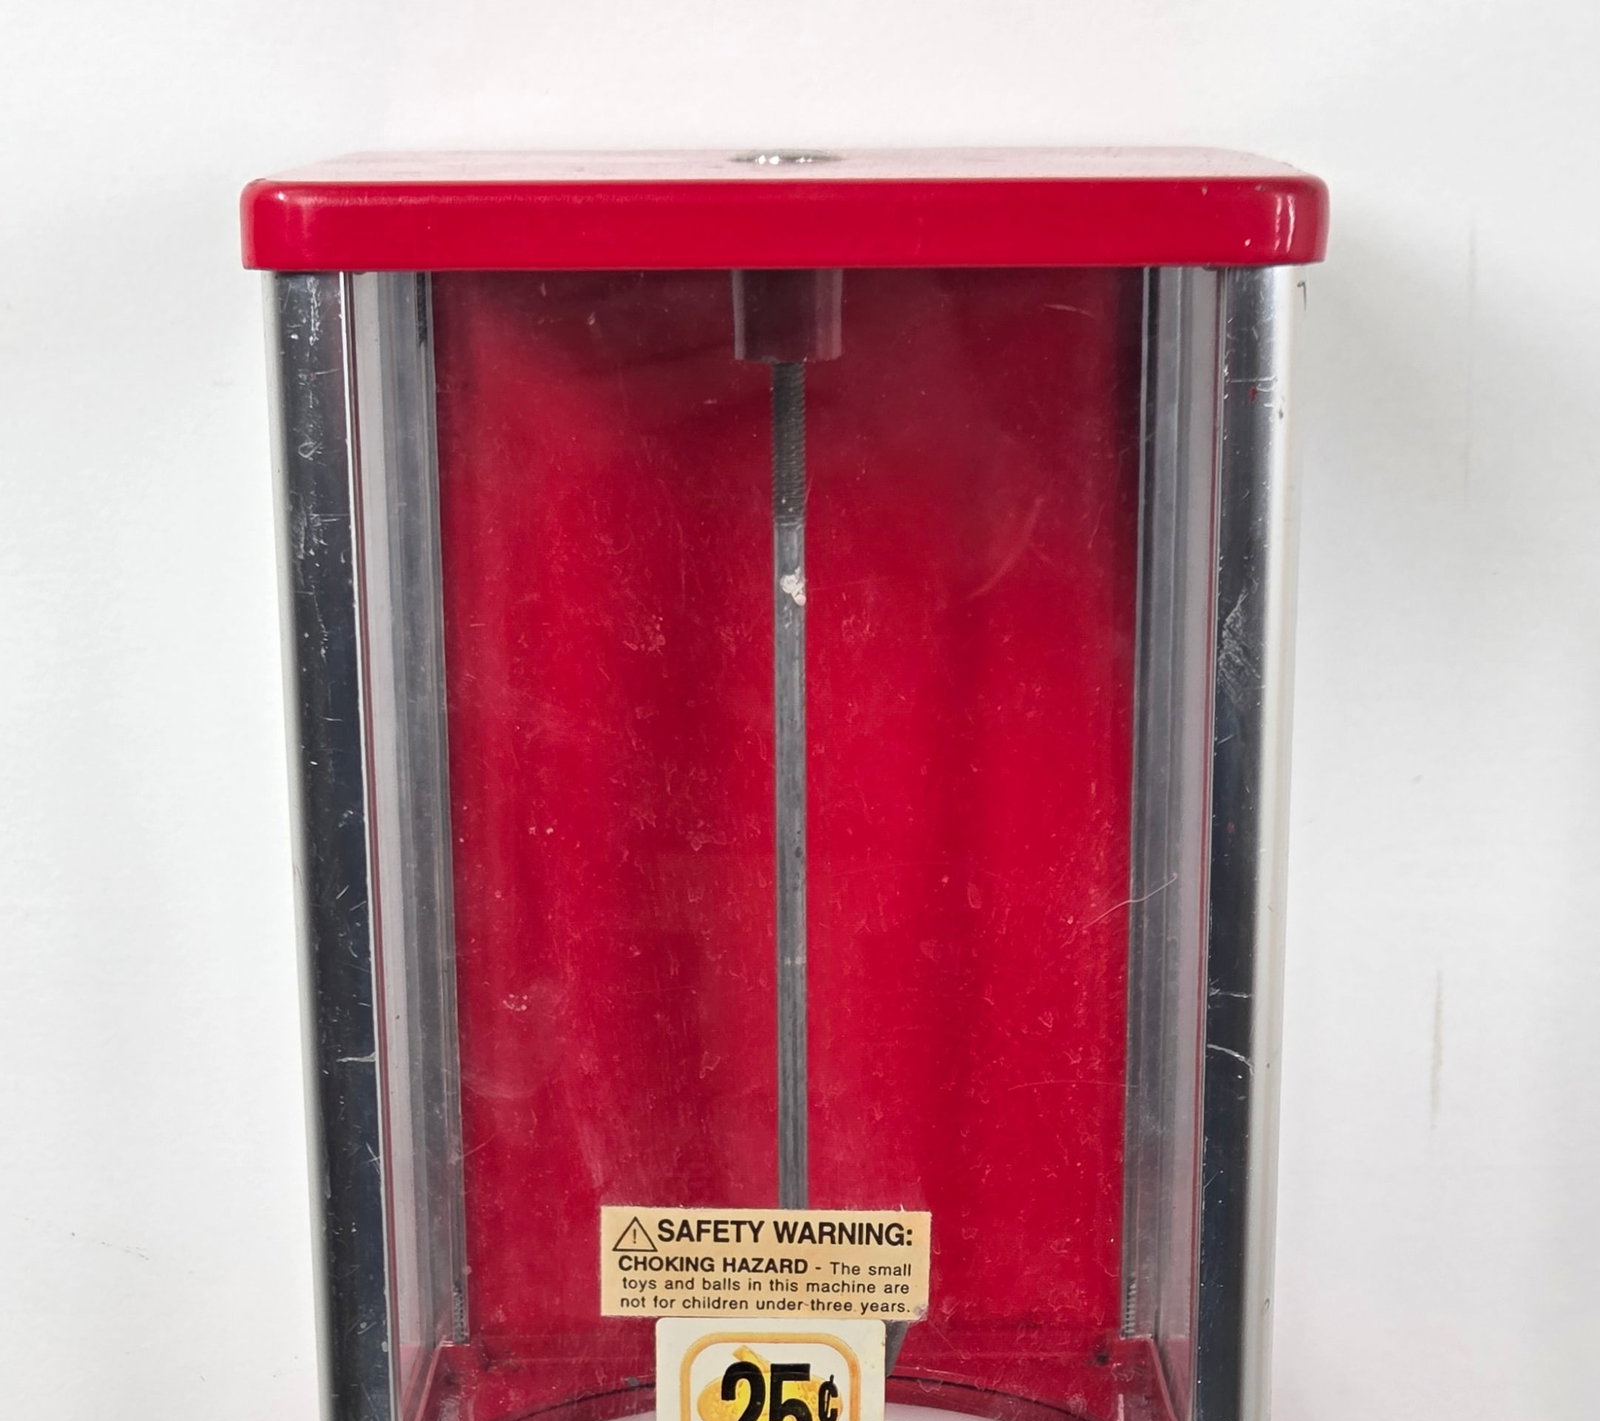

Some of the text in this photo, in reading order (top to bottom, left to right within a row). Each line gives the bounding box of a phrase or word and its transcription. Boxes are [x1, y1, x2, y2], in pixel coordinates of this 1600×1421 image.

[657, 1218, 913, 1246] SAFETY WARNING:
[618, 1255, 715, 1272] CHOKING
[722, 1257, 808, 1274] HAZARD
[830, 1261, 861, 1276] The
[868, 1263, 912, 1277] small
[622, 1276, 910, 1294] toys and balls in this machine are
[620, 1295, 911, 1315] not for children under three years.
